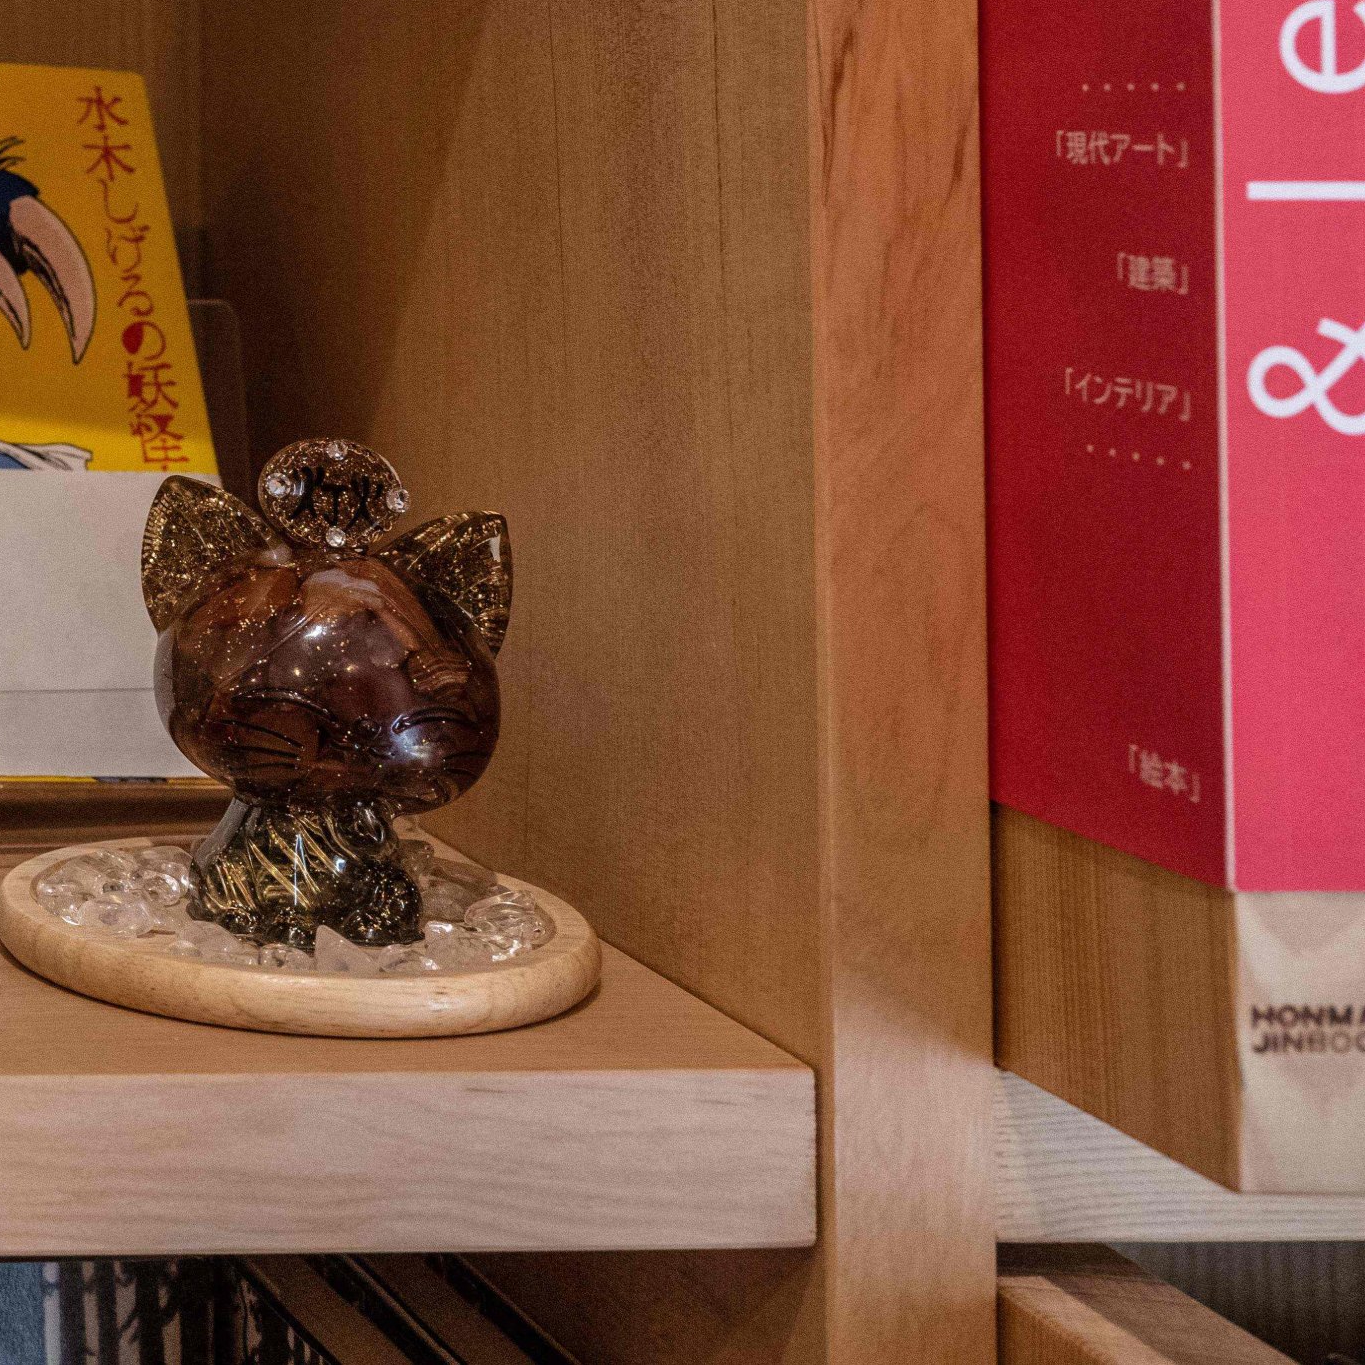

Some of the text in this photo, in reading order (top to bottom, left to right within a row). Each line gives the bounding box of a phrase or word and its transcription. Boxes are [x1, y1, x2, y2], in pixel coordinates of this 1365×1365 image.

[76, 85, 190, 471] 水木しげるの妖怪
[1251, 1004, 1365, 1029] HONM
